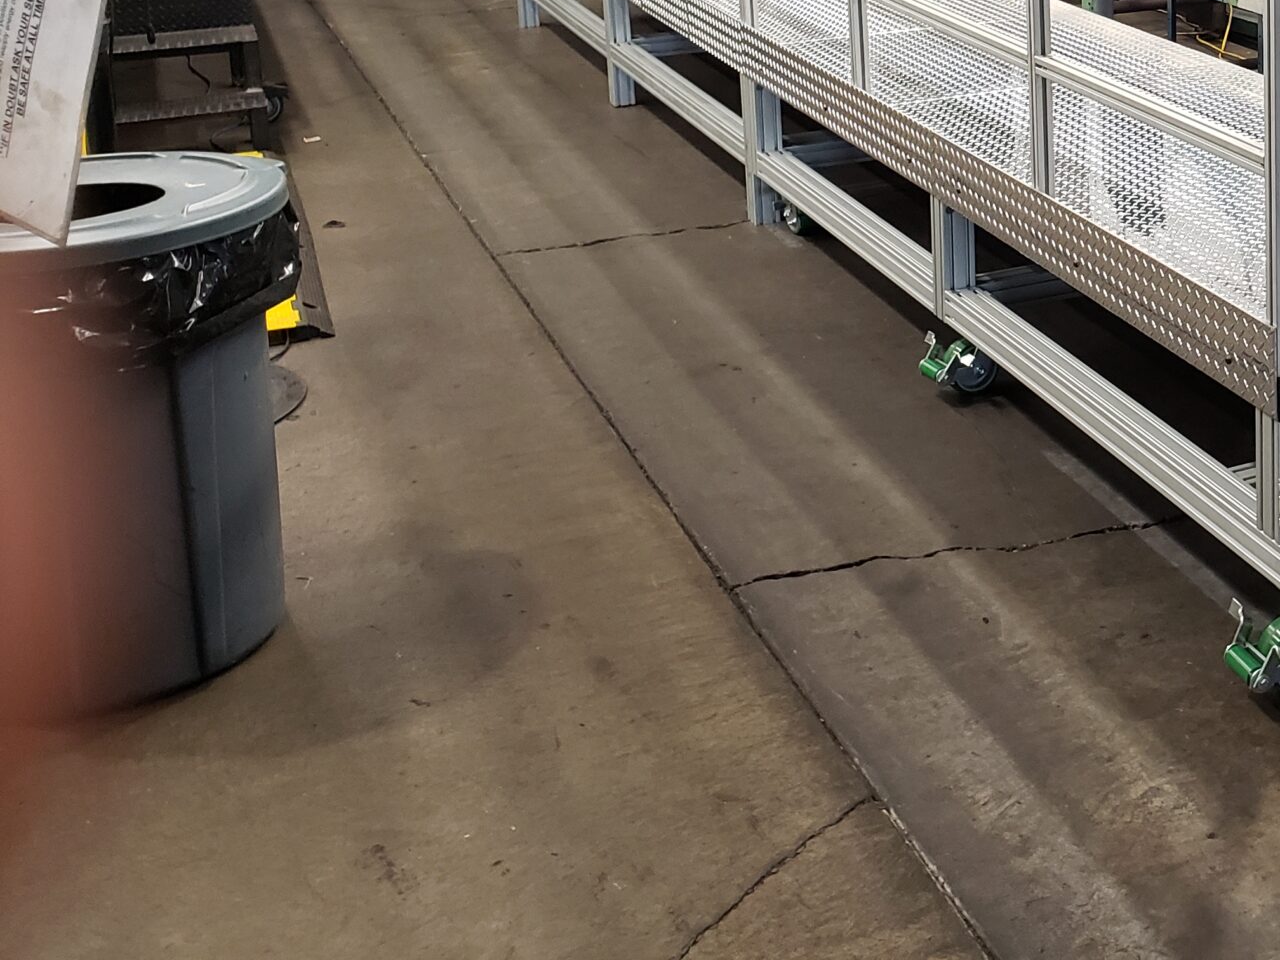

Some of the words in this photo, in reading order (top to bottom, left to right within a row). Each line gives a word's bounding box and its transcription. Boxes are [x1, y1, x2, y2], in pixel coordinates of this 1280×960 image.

[16, 12, 30, 44] YOUR
[28, 24, 39, 46] ALL
[11, 48, 22, 74] ASK
[24, 46, 33, 64] AT
[19, 65, 31, 97] SAFE
[5, 75, 18, 117] DOUBT
[16, 99, 25, 117] BE
[3, 120, 12, 133] IN
